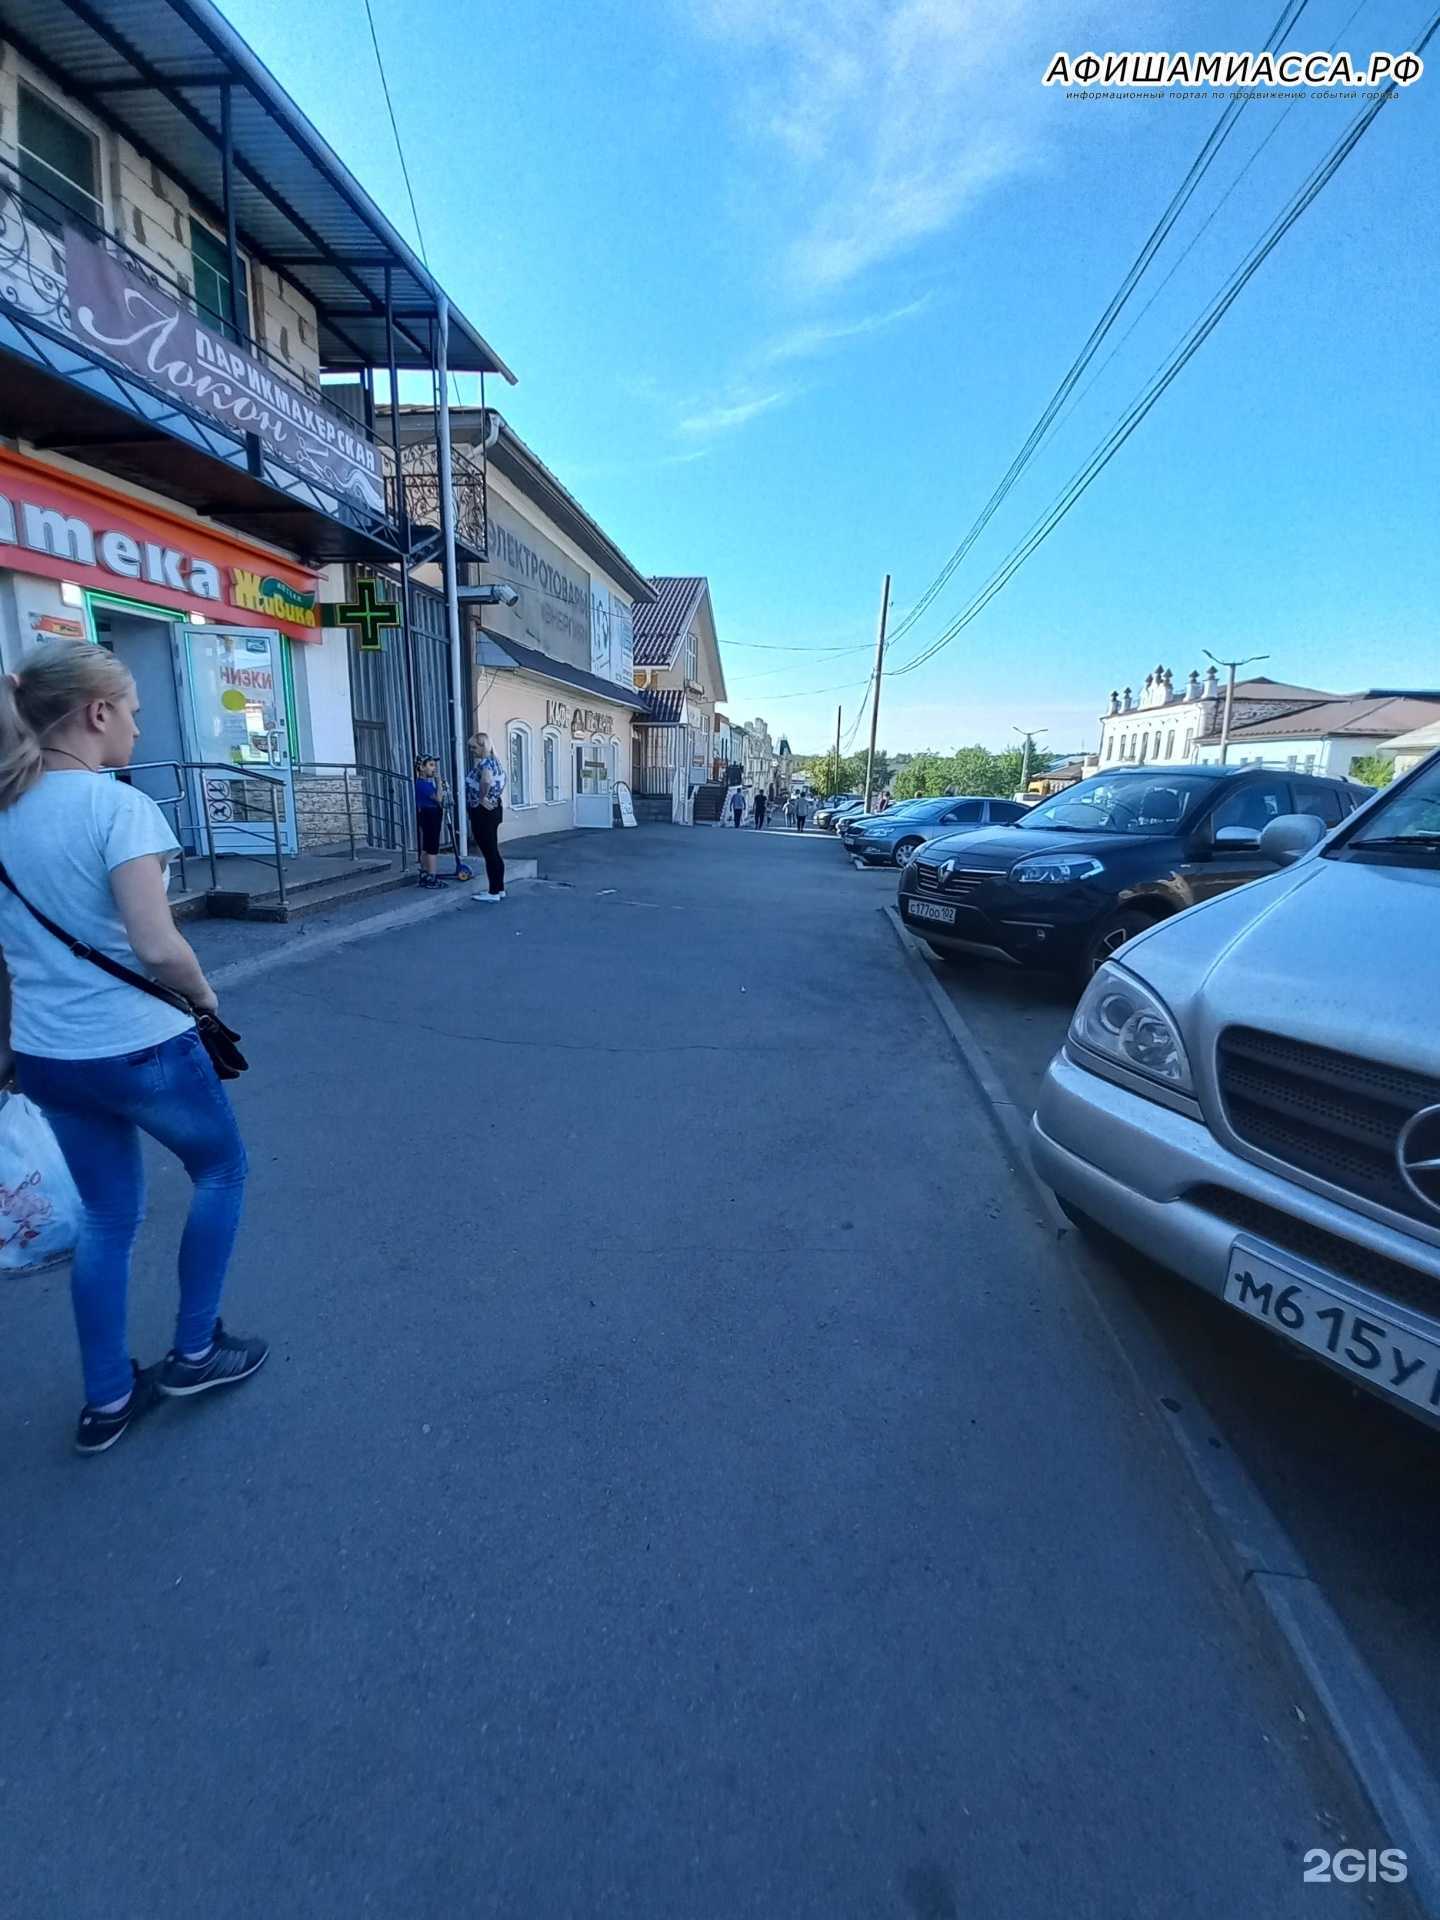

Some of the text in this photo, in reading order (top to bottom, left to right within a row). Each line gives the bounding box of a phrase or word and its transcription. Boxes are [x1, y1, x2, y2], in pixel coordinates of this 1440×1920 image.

[78, 288, 287, 442] Локон
[196, 328, 376, 472] ПАРИКМАХЕРСКАЯ
[486, 519, 590, 618] ЭЛЕКТРОТОВАРЫ
